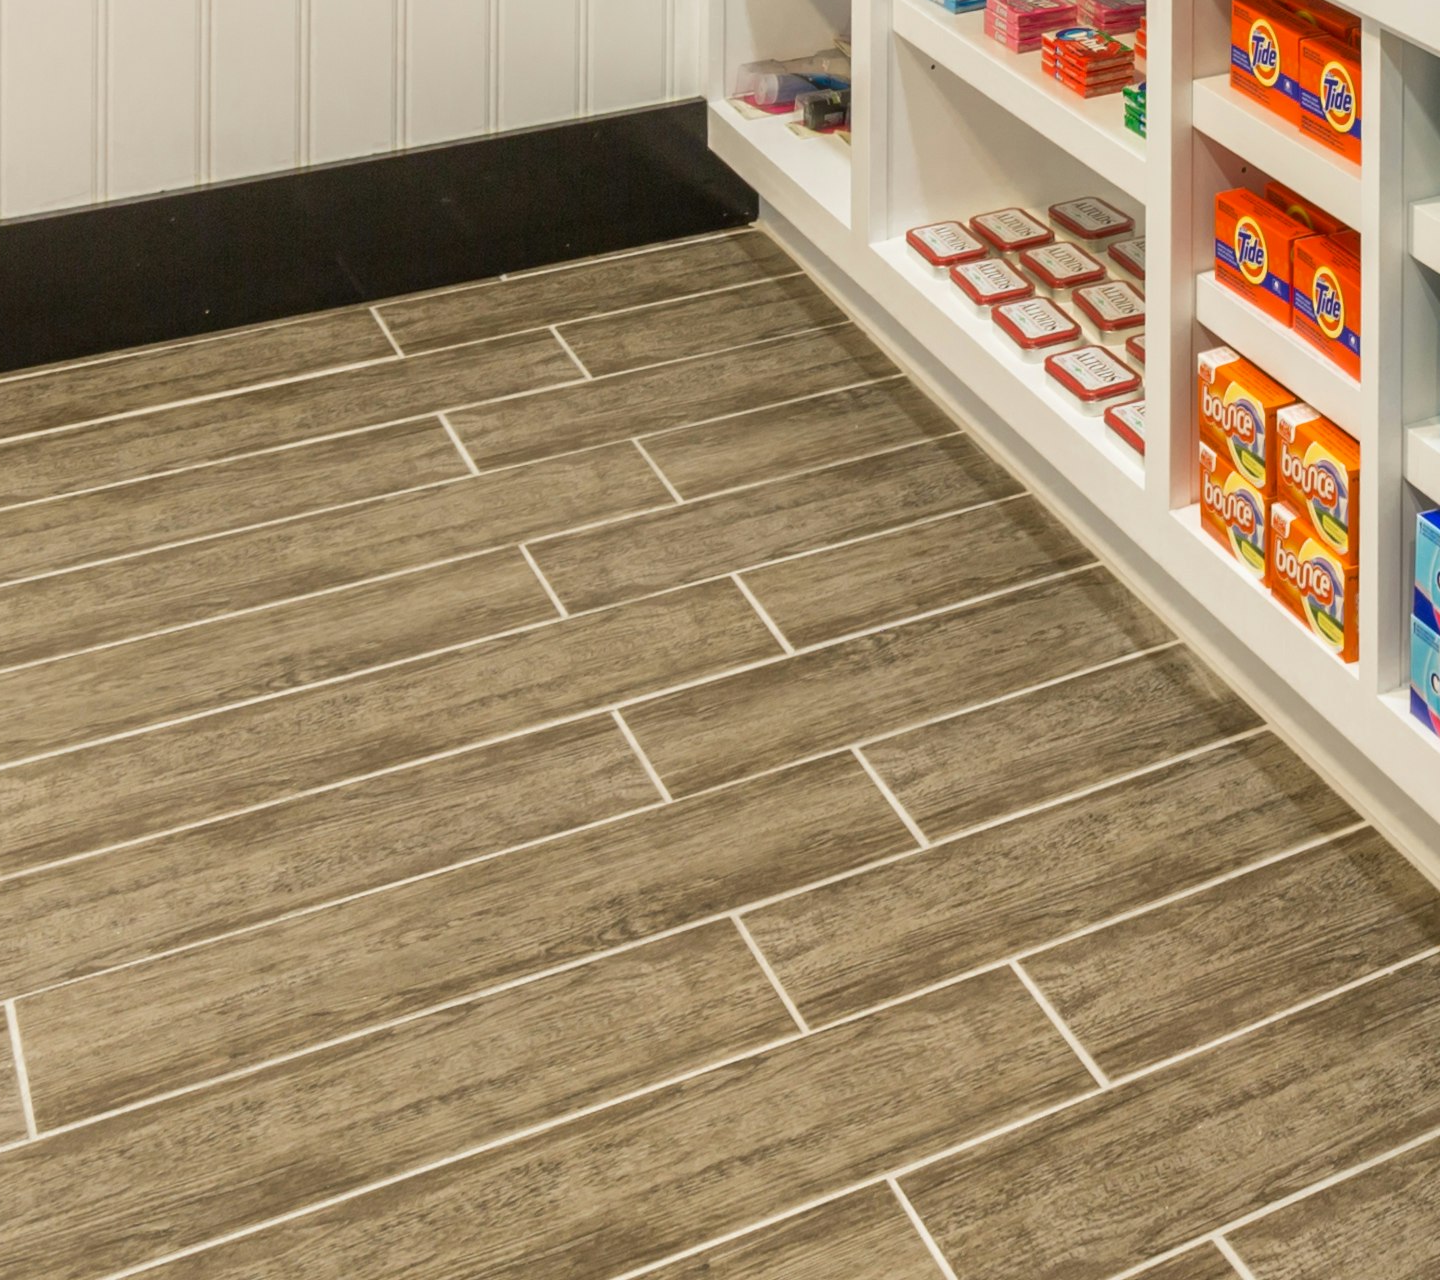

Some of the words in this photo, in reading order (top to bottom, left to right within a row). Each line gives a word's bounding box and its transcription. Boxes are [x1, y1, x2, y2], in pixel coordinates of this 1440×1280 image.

[1252, 35, 1277, 67] Tide
[1324, 78, 1352, 112] Tide
[1238, 231, 1264, 265] Tide
[1316, 282, 1341, 318] Tide
[1203, 384, 1255, 437] bounce
[1282, 442, 1335, 501] bounce
[1204, 471, 1254, 528] bounce
[1275, 539, 1331, 598] bounce
